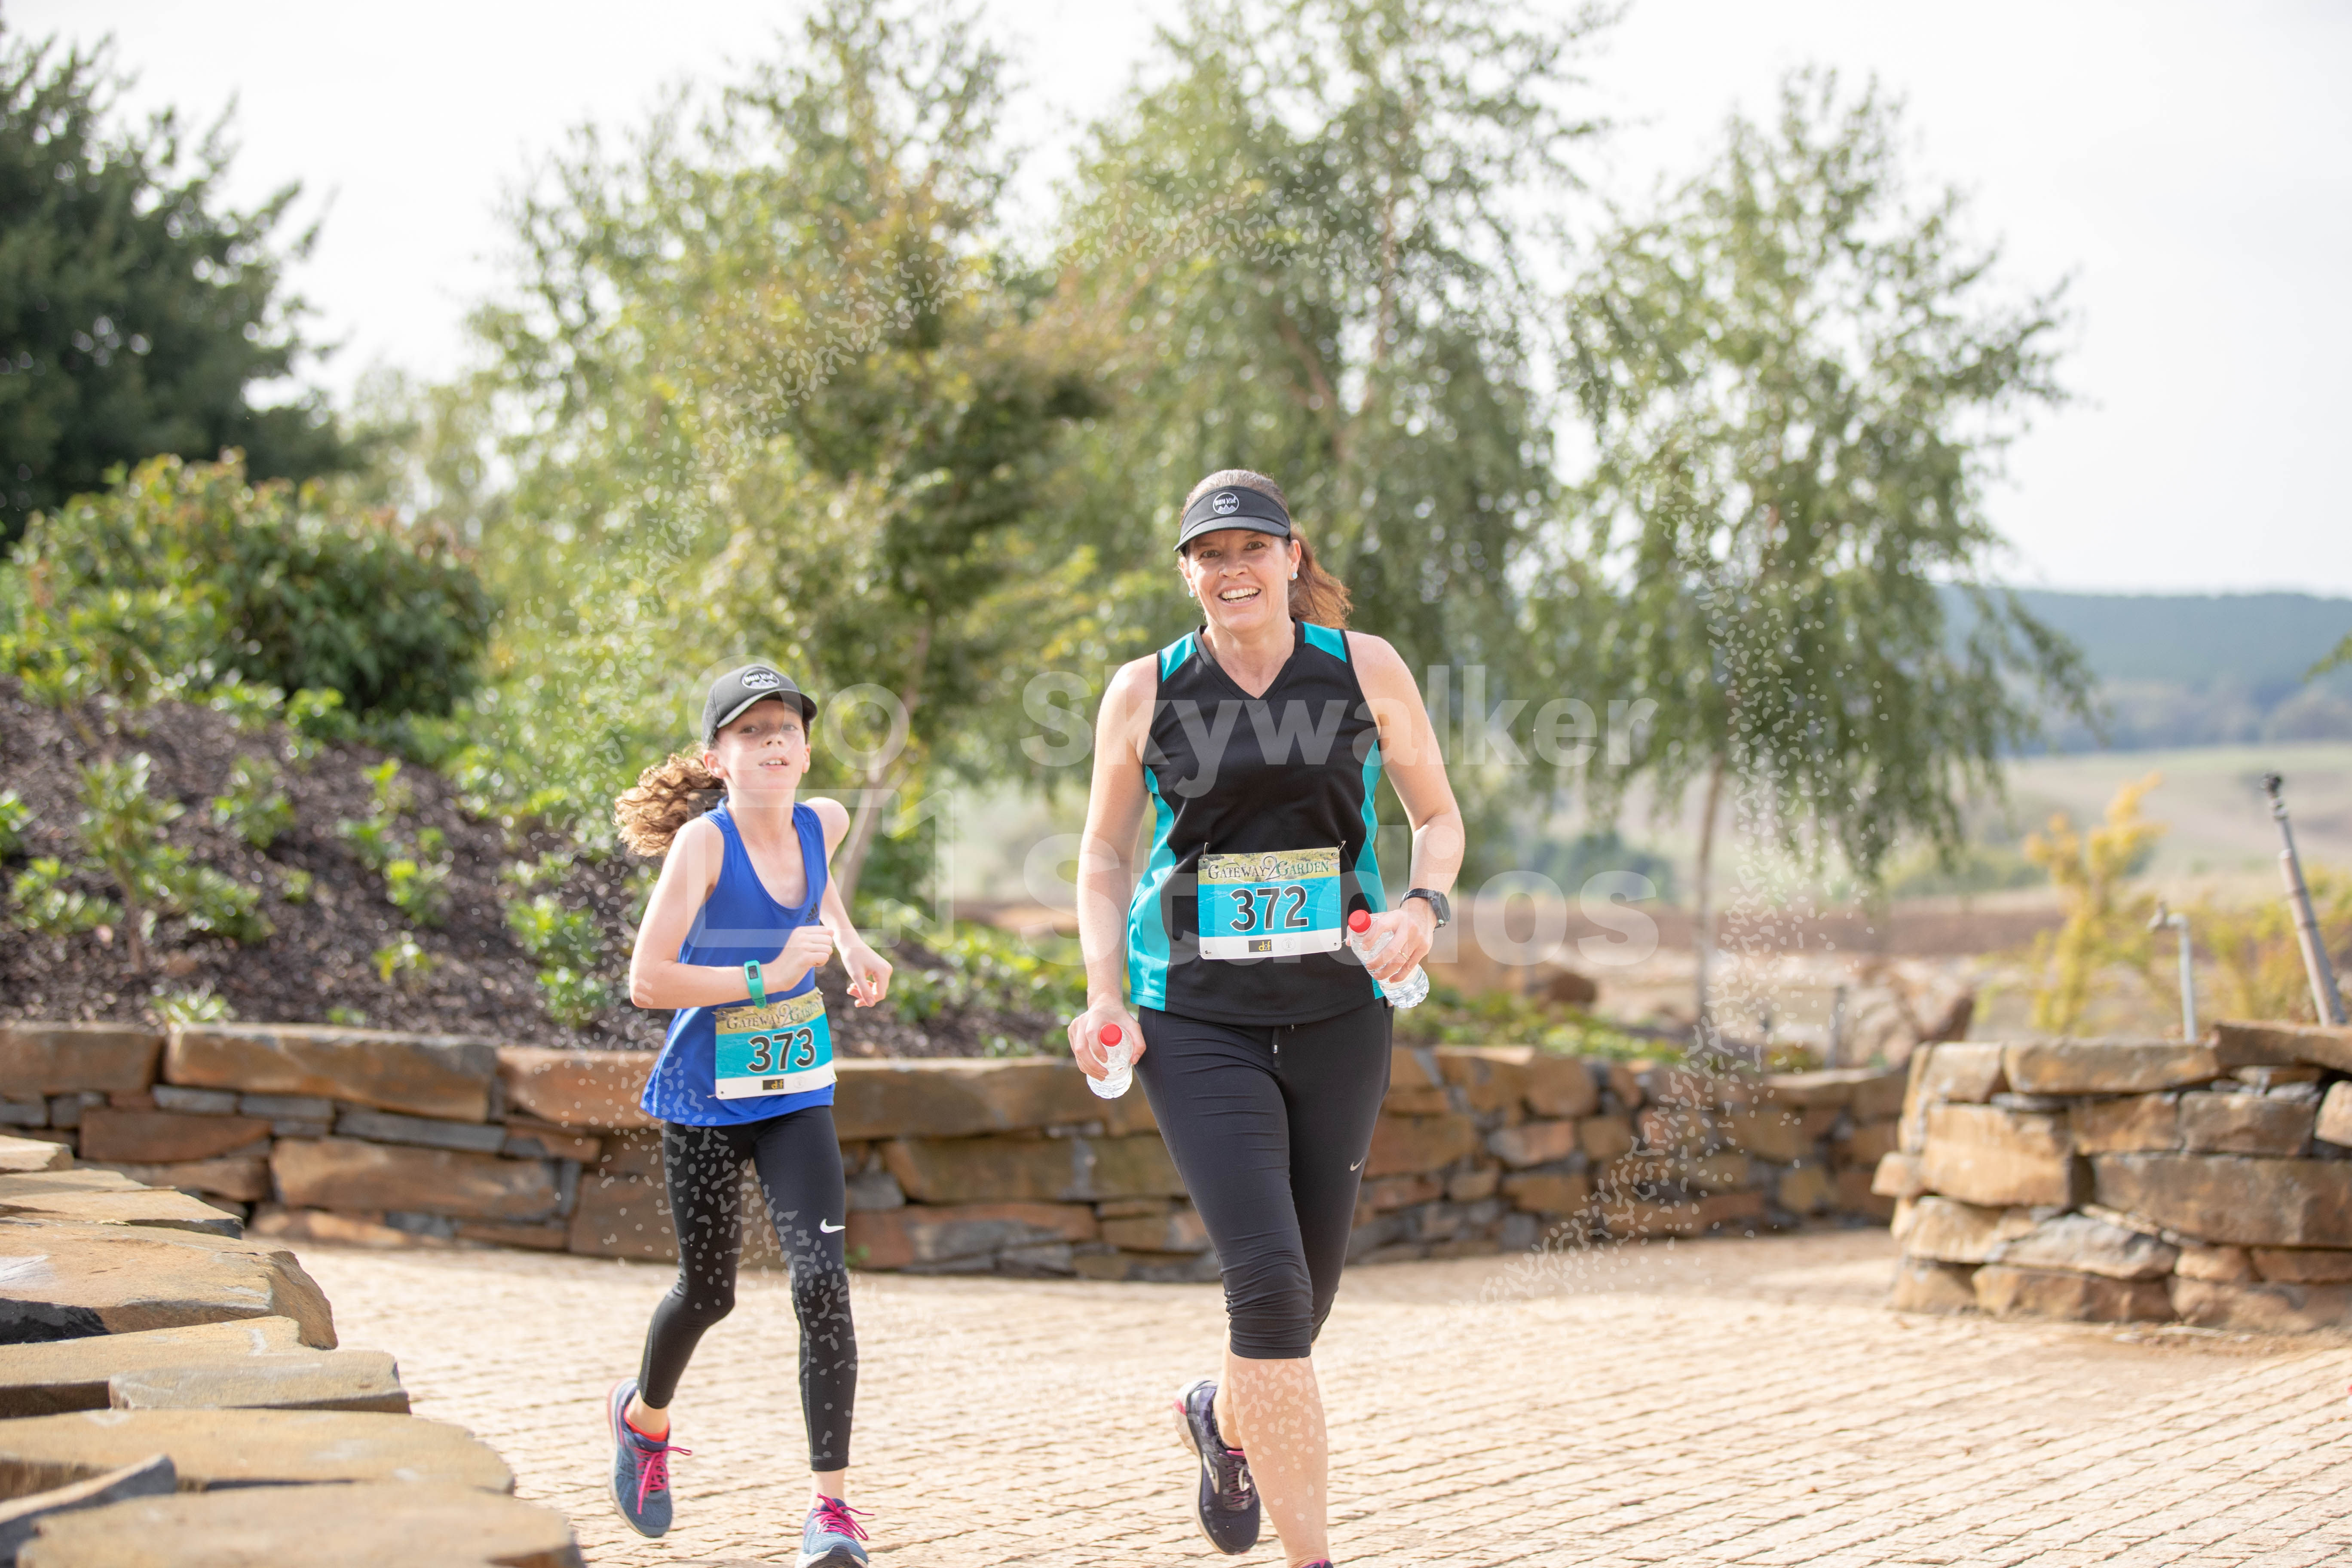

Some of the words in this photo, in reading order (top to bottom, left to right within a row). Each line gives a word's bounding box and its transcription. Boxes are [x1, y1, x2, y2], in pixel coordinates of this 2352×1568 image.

[1230, 885, 1308, 931] 372
[1259, 941, 1271, 951] d2f
[747, 1028, 816, 1072] 373
